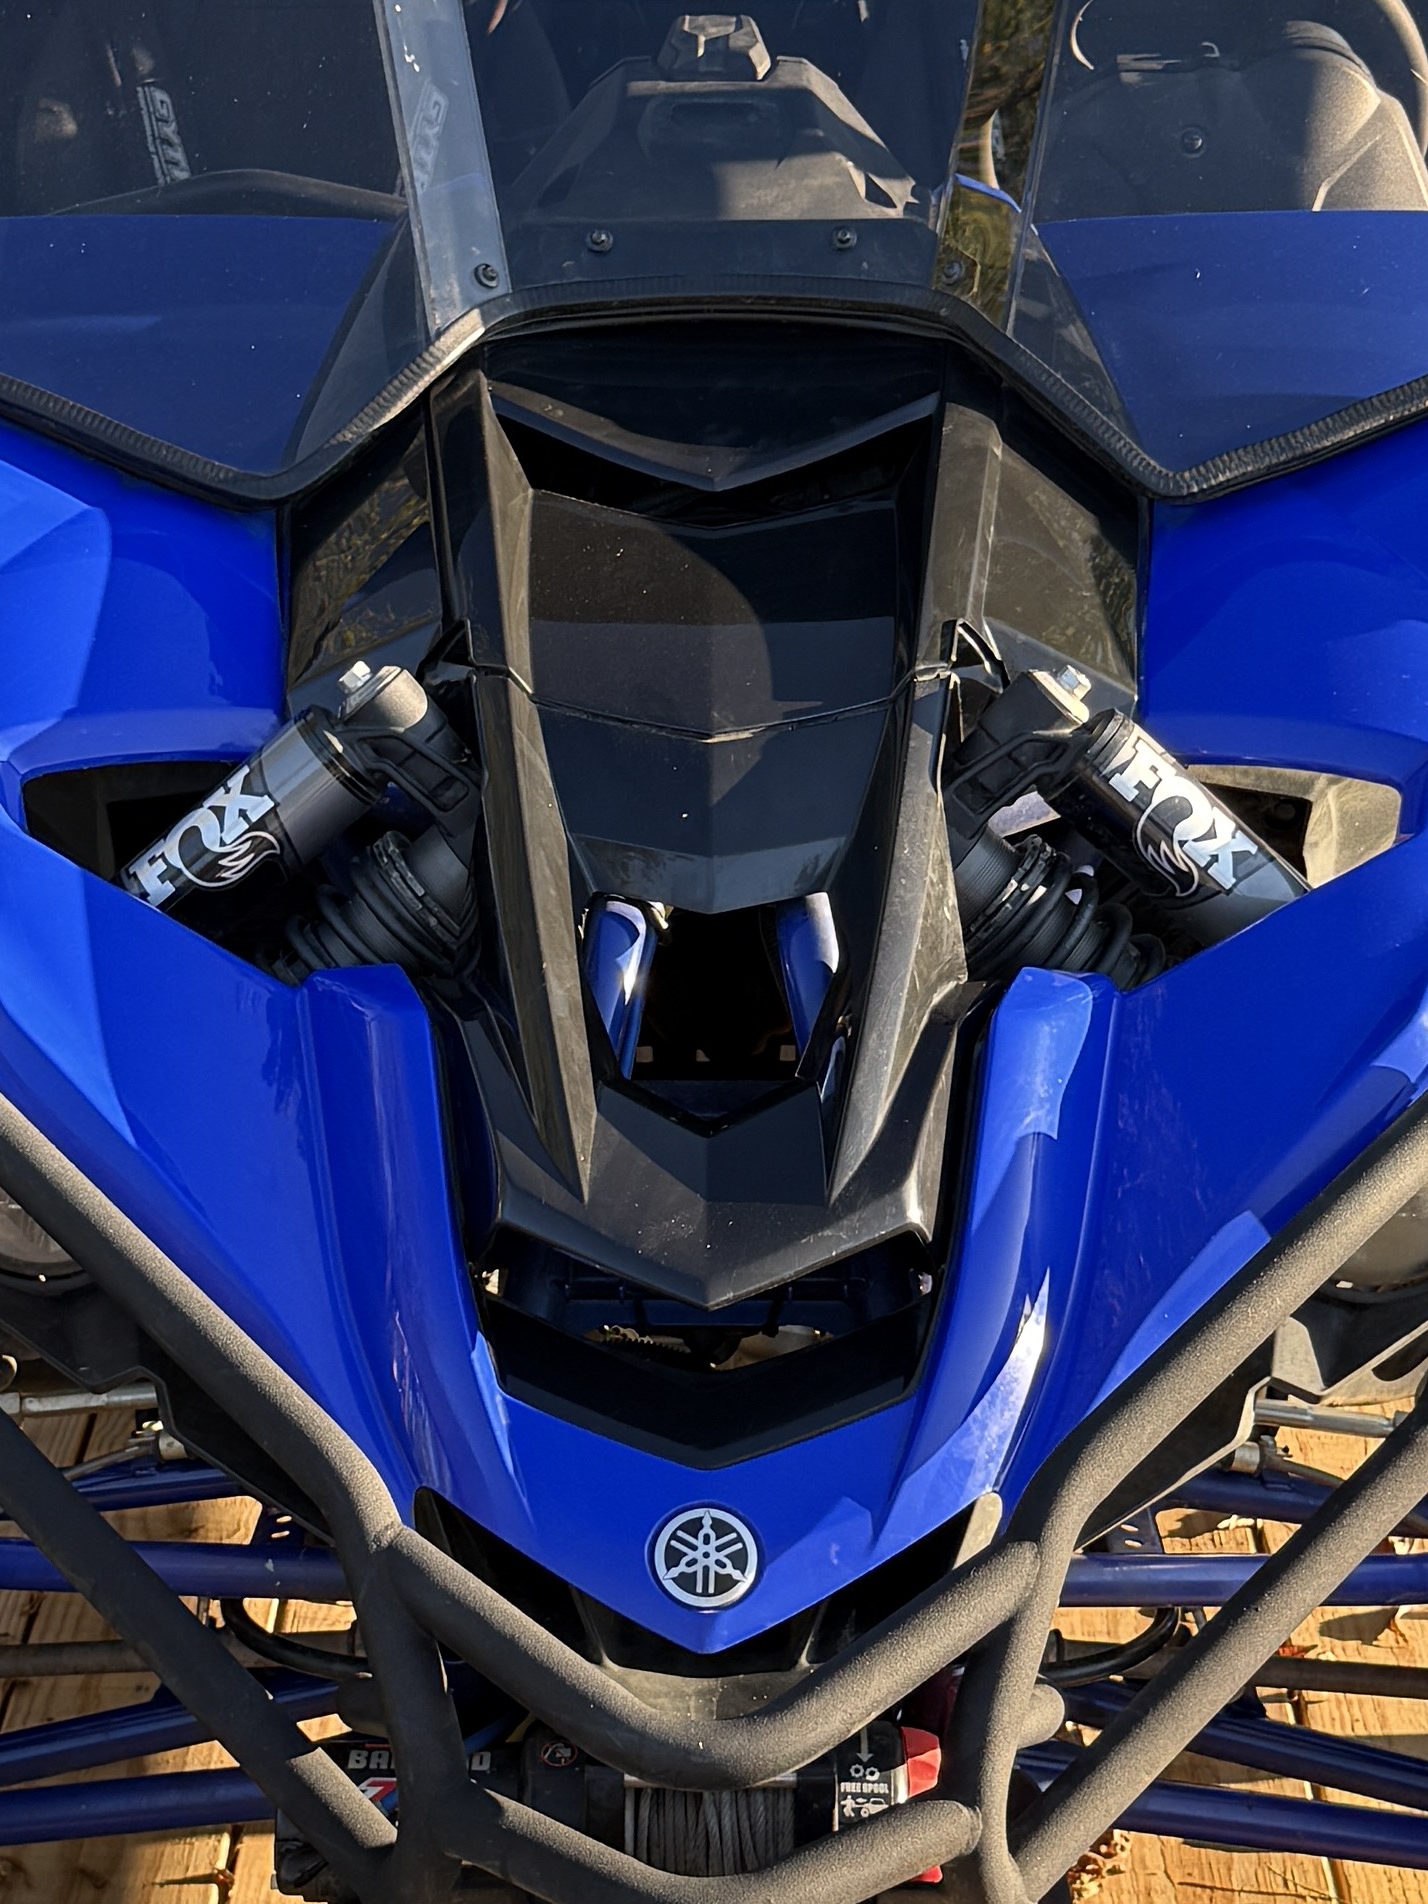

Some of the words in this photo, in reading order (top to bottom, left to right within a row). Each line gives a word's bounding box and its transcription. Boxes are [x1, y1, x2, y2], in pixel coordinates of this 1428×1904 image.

[128, 764, 278, 907] FOX
[1108, 738, 1259, 897] FOX
[840, 1782, 861, 1793] FREE
[863, 1783, 889, 1794] SPOOL
